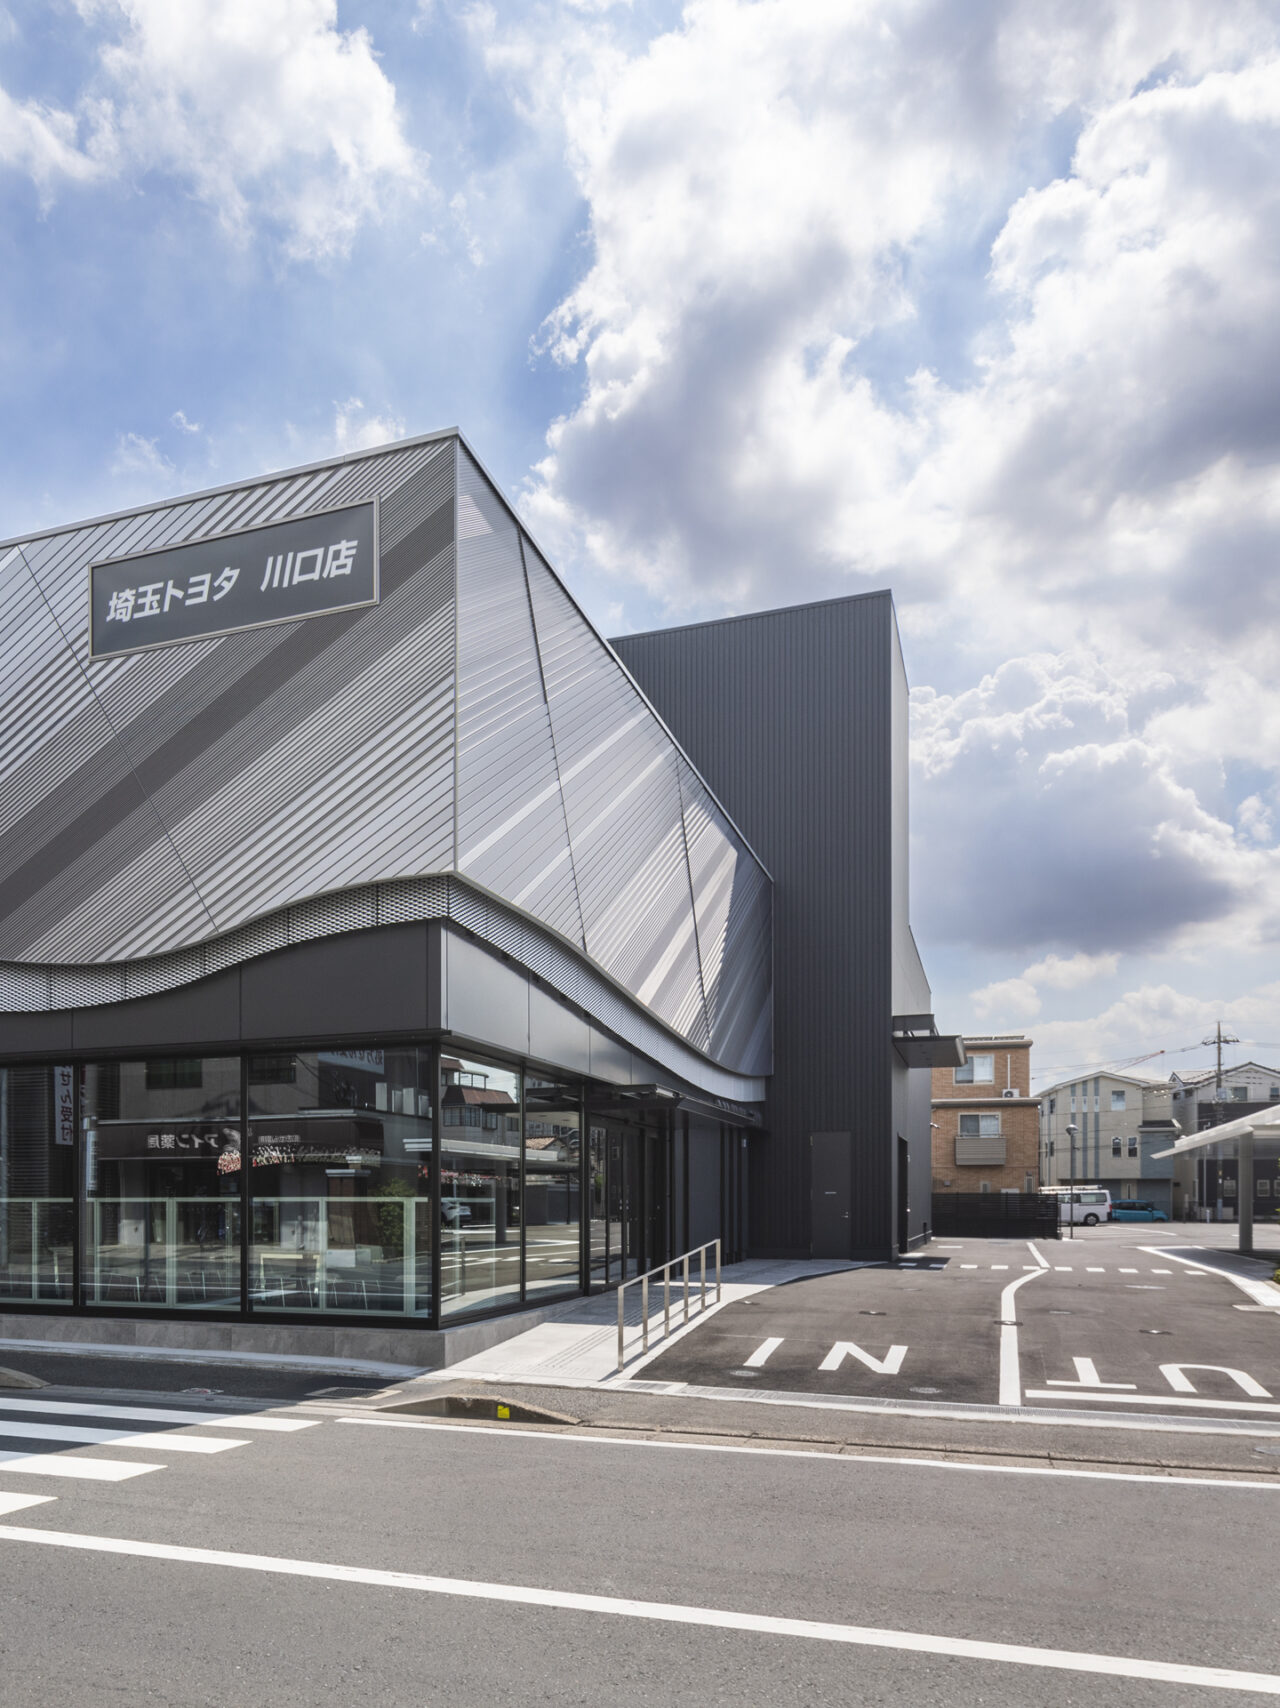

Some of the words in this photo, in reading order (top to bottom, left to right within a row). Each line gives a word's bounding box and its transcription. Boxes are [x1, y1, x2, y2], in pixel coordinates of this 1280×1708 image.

[106, 566, 241, 622] 埼玉トヨタ
[260, 540, 359, 592] 川口店
[743, 1337, 909, 1374] IN
